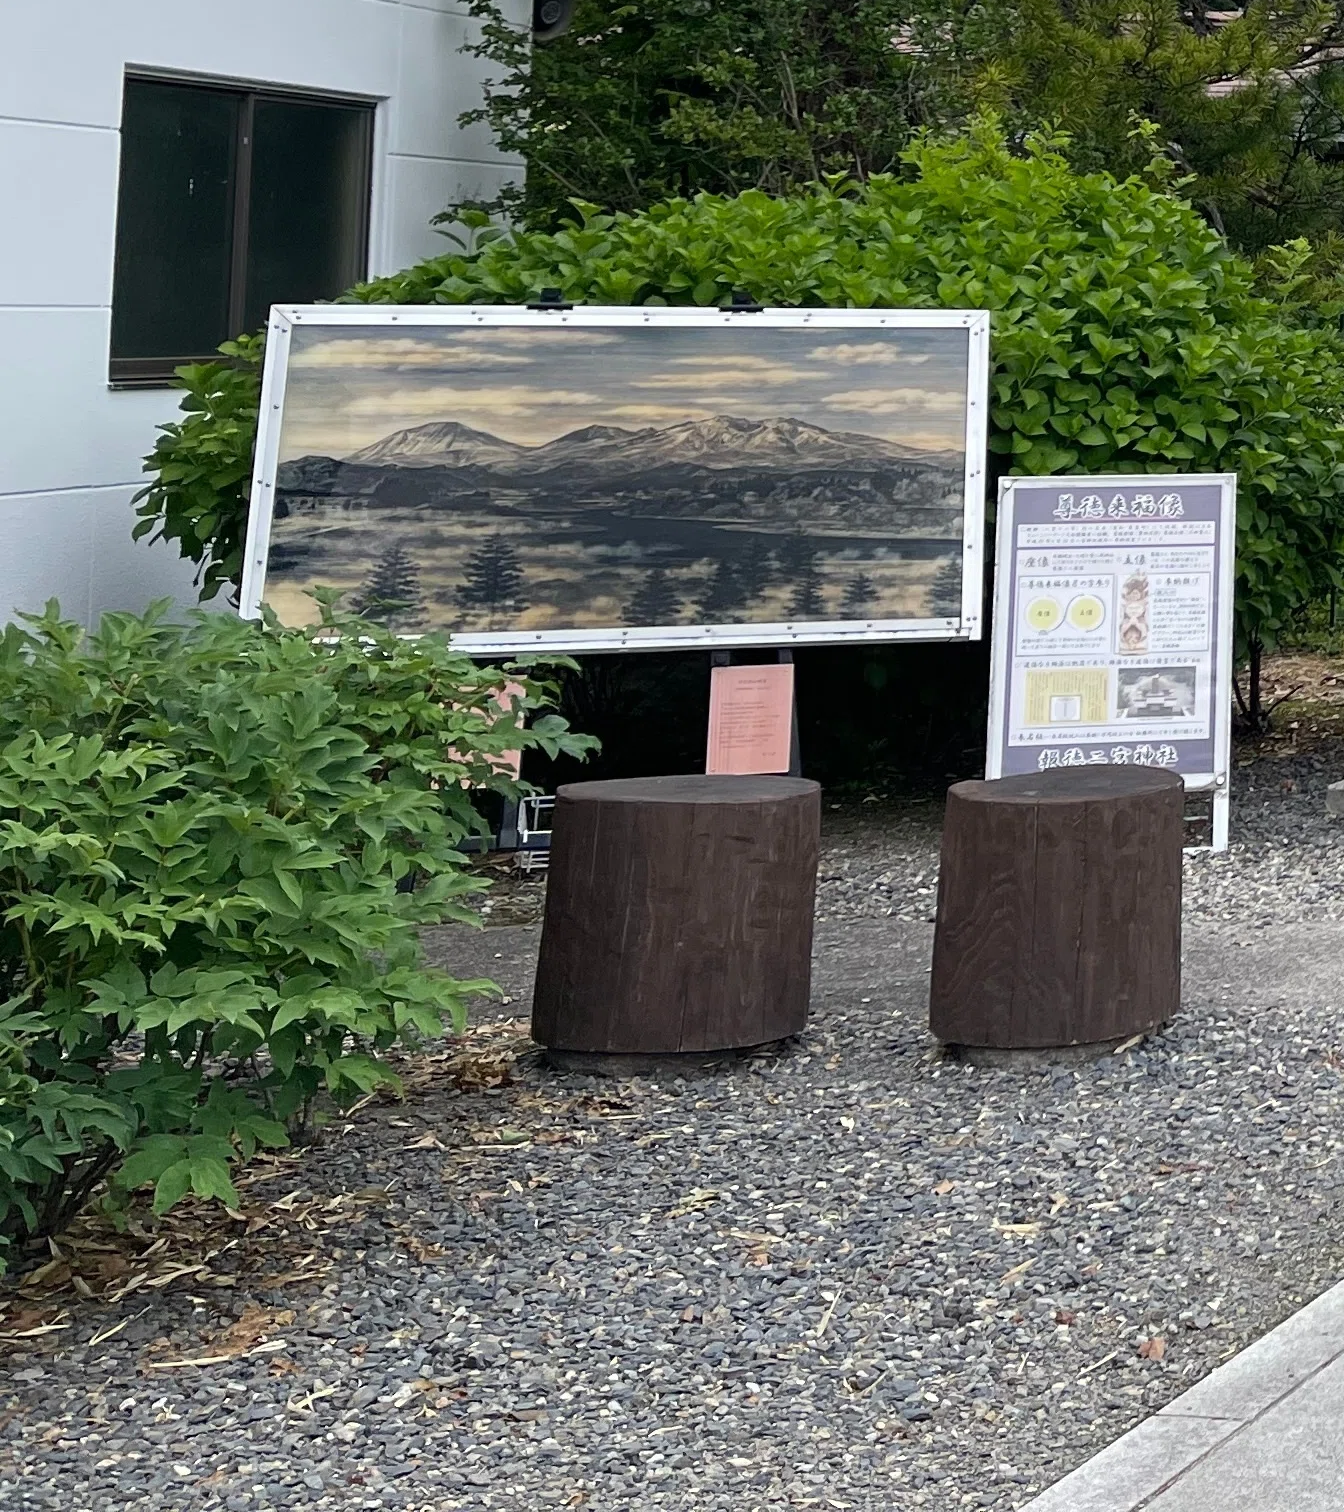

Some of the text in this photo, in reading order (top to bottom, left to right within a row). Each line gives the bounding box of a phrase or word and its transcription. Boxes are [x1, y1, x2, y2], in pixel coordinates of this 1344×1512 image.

[1053, 493, 1185, 520] 尊徳来福像
[1037, 743, 1179, 771] 報徳二宮神社
